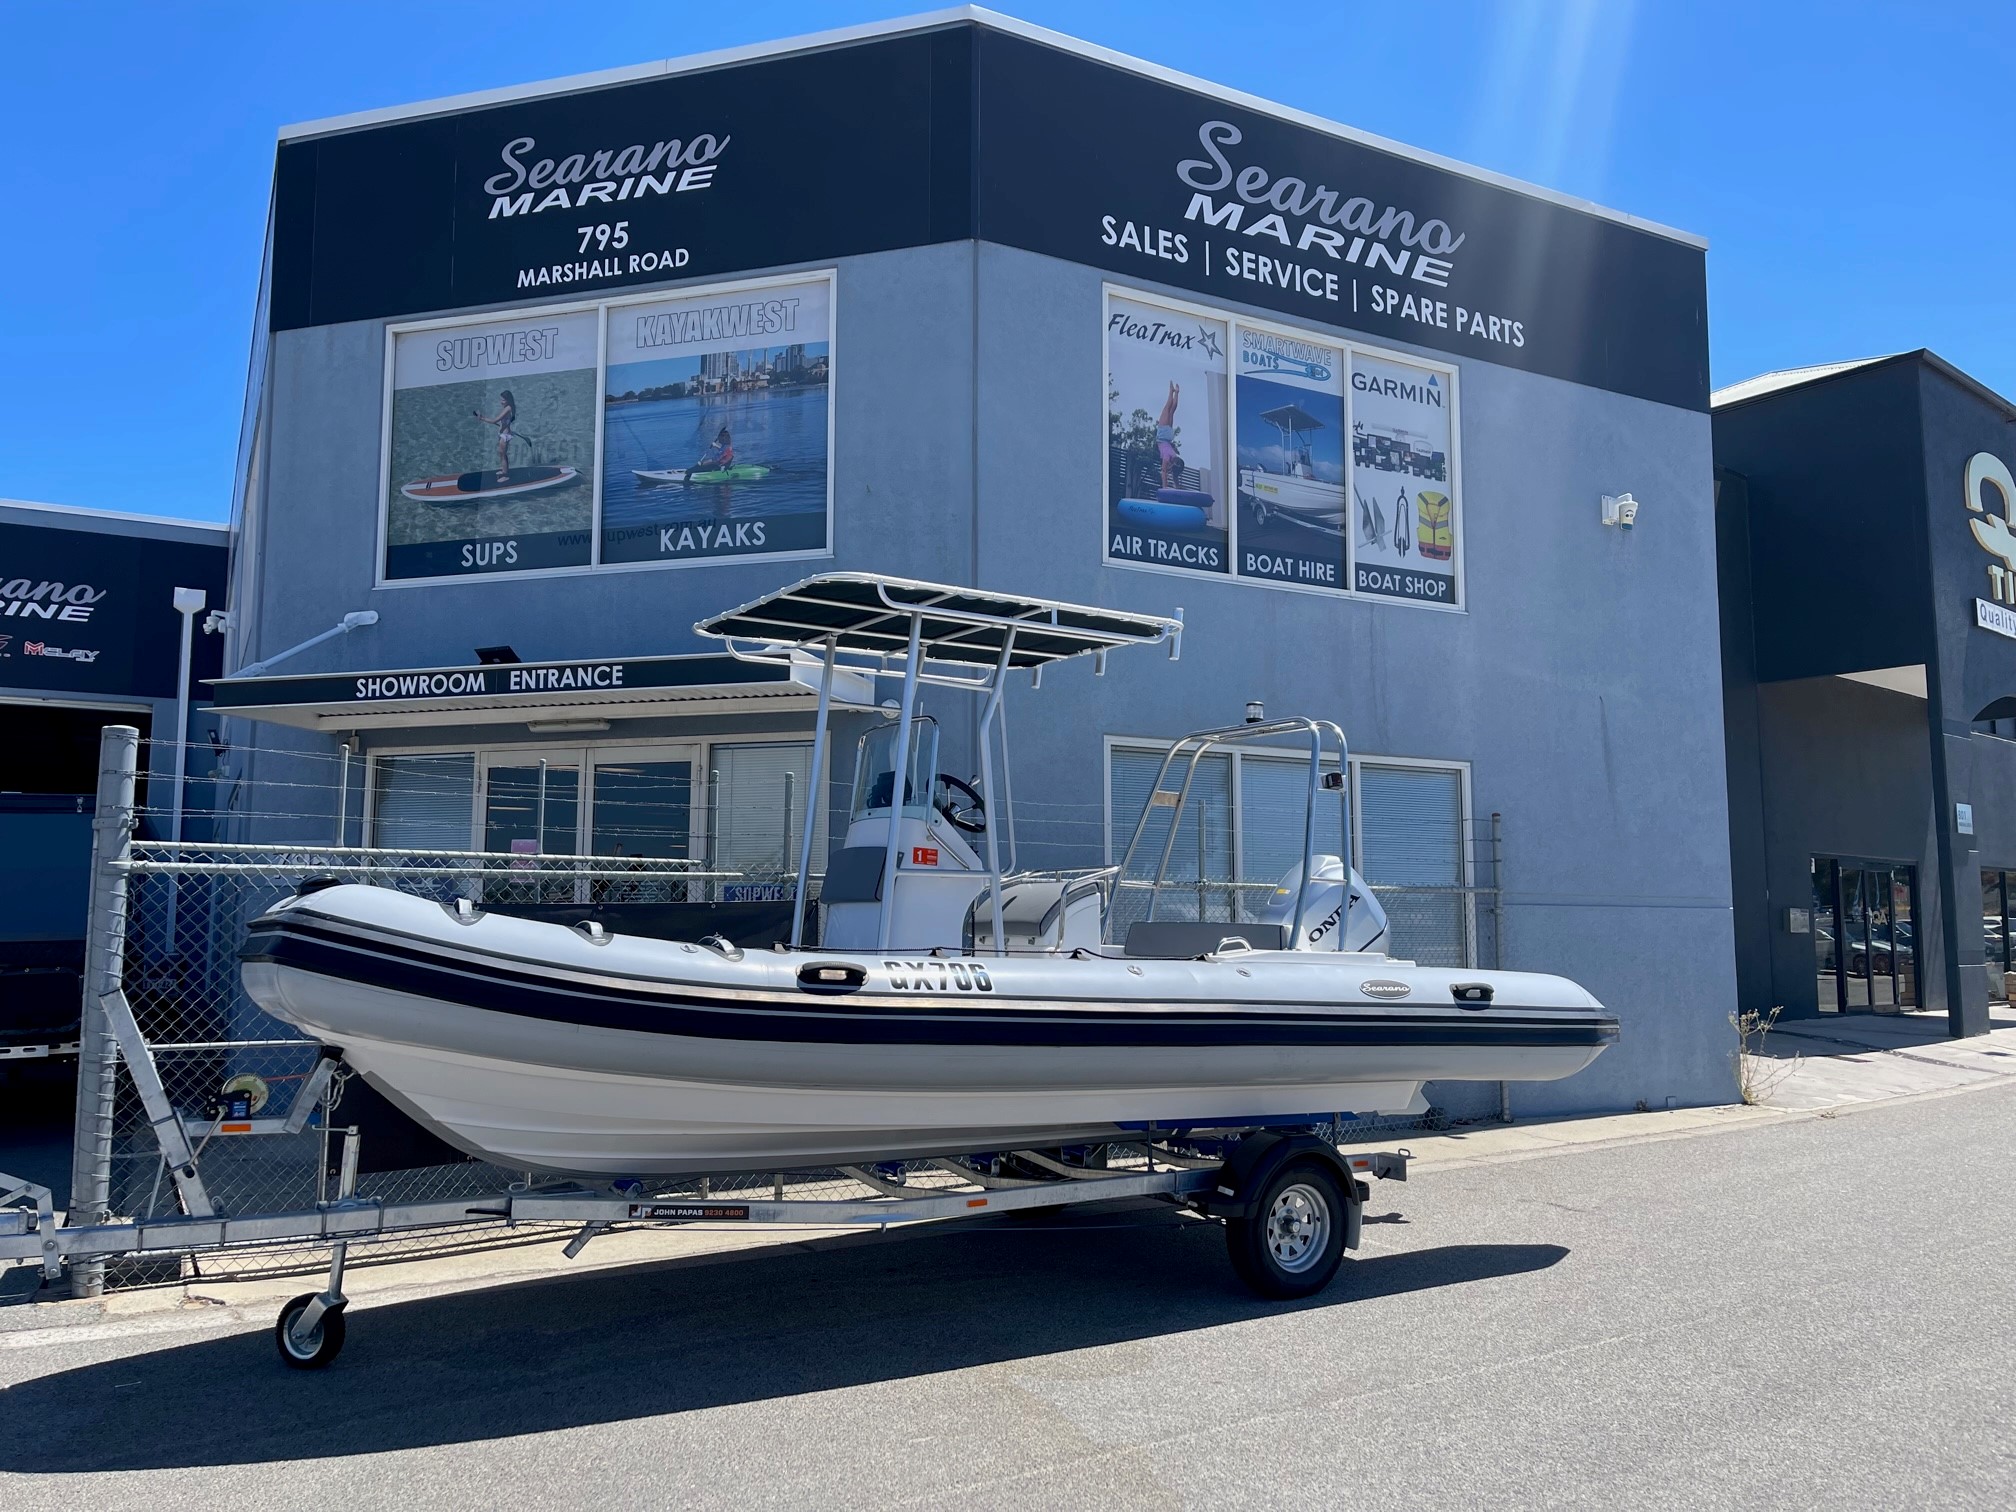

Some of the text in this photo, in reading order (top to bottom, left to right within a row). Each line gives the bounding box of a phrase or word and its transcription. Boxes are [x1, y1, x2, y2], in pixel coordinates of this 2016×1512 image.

[484, 133, 731, 195] Searano
[488, 164, 718, 219] MARINE
[1176, 120, 1466, 255] Searano
[577, 221, 629, 254] 795
[1184, 192, 1454, 288] MARINE
[517, 248, 690, 288] MARSHALL ROAD
[1101, 215, 1525, 347] SALES SERVICE SPARE PARTS
[636, 298, 800, 348] KAYAKWEST
[1108, 313, 1196, 350] FleaTrax
[436, 327, 559, 371] SUPWEST
[1243, 330, 1331, 366] SMARTWAVE
[1243, 350, 1279, 369] BOATS
[1352, 372, 1441, 407] GARMIN
[461, 541, 518, 568] SUPS
[660, 522, 767, 553] KAYAKS
[1111, 534, 1218, 567] AIR TRACKS
[1246, 553, 1335, 582] BOAT HIRE
[1358, 570, 1446, 597] BOAT SHOP
[1988, 565, 2016, 604] TI
[0, 578, 107, 604] ano
[356, 665, 623, 698] SHOWROOM ENTRANCE
[735, 886, 797, 901] SUPWET
[1309, 894, 1360, 946] ONA
[1362, 983, 1410, 992] Searano
